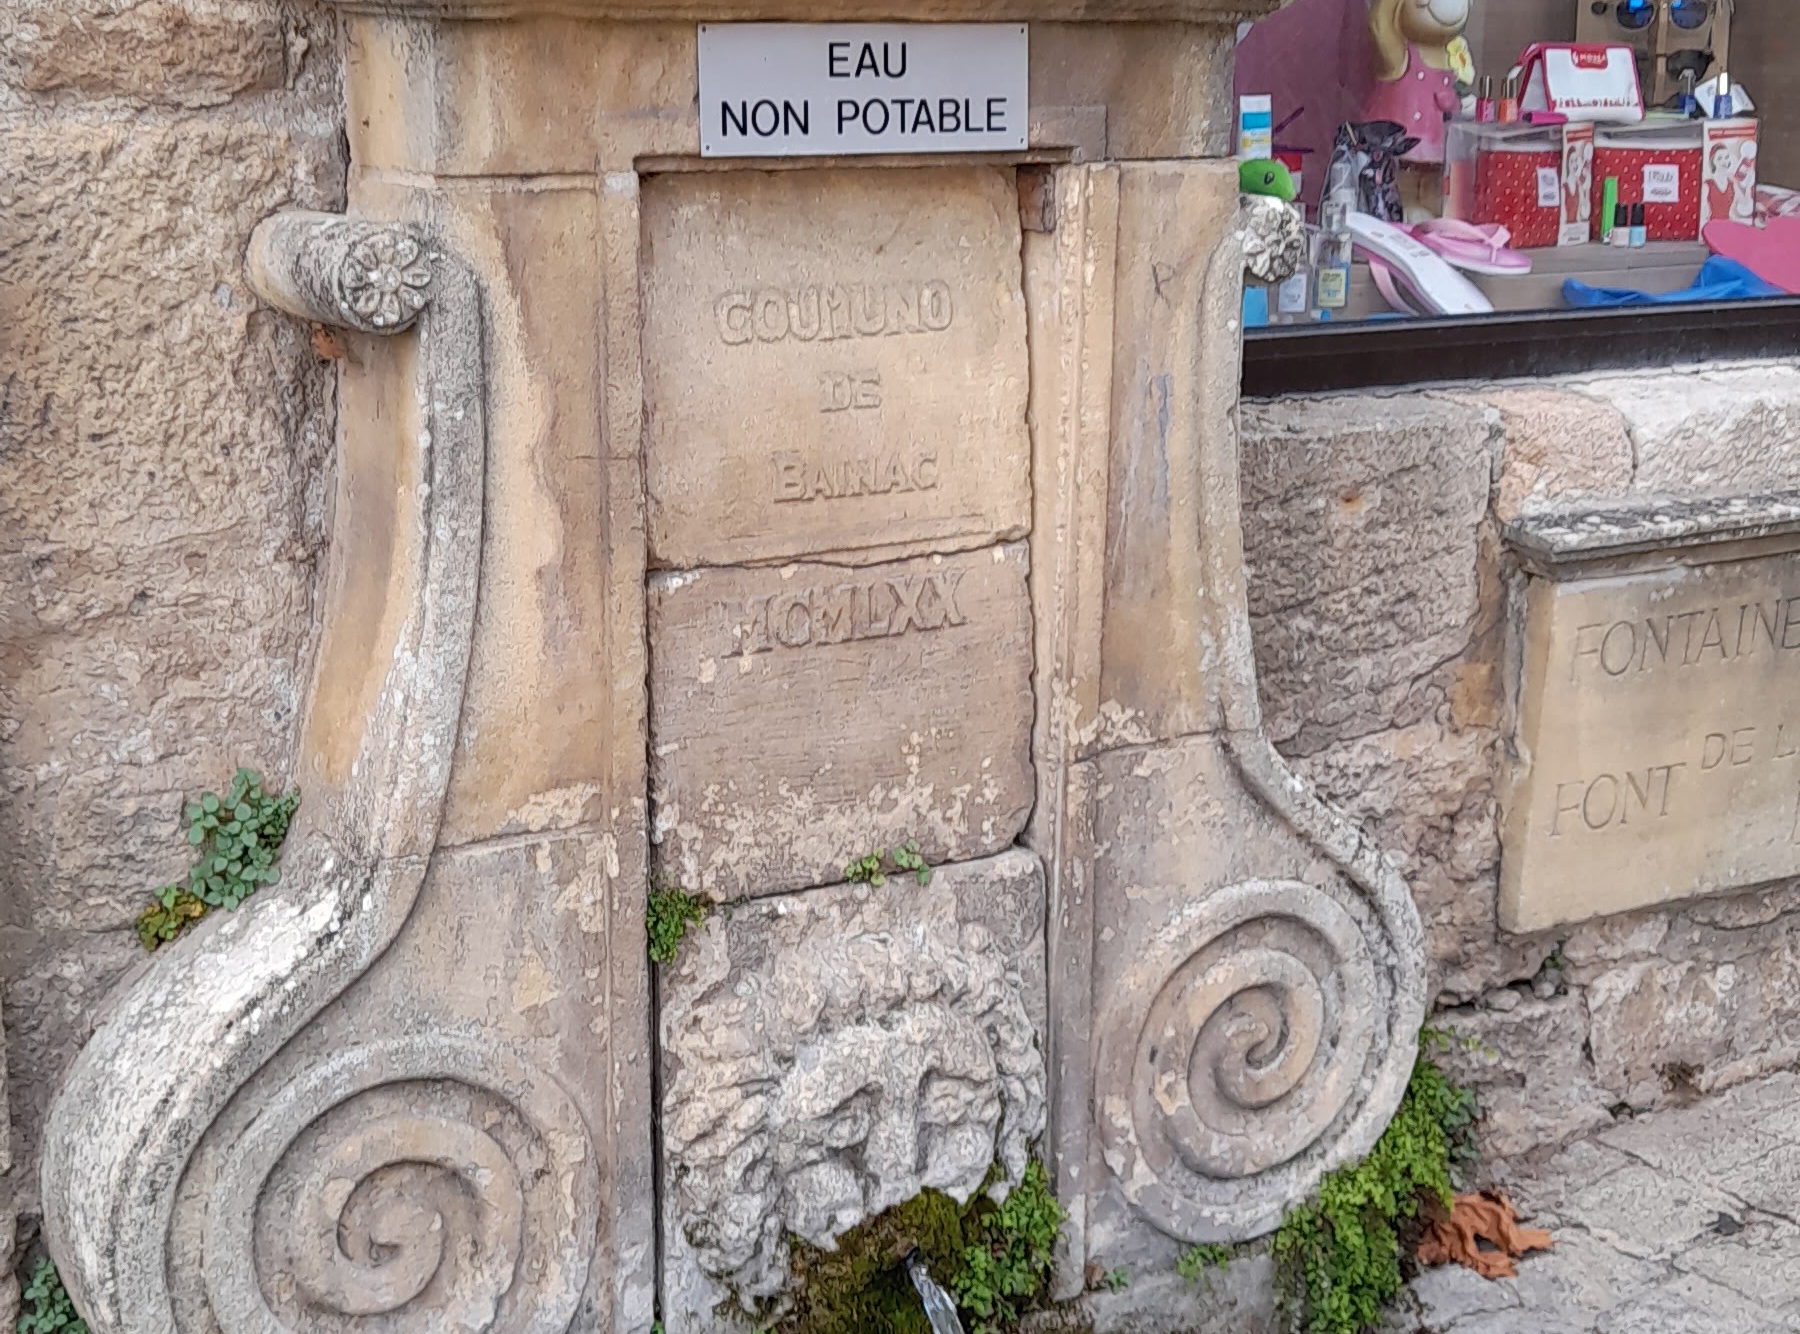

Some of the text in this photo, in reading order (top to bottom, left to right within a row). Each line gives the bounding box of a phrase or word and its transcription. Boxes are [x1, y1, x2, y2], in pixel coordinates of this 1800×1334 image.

[828, 41, 908, 79] EAU
[721, 97, 1008, 137] NON POTABLE
[818, 369, 882, 414] DE
[1570, 596, 1800, 685] FONTAINE
[1548, 762, 1687, 837] FONT
[1701, 727, 1756, 769] DE
